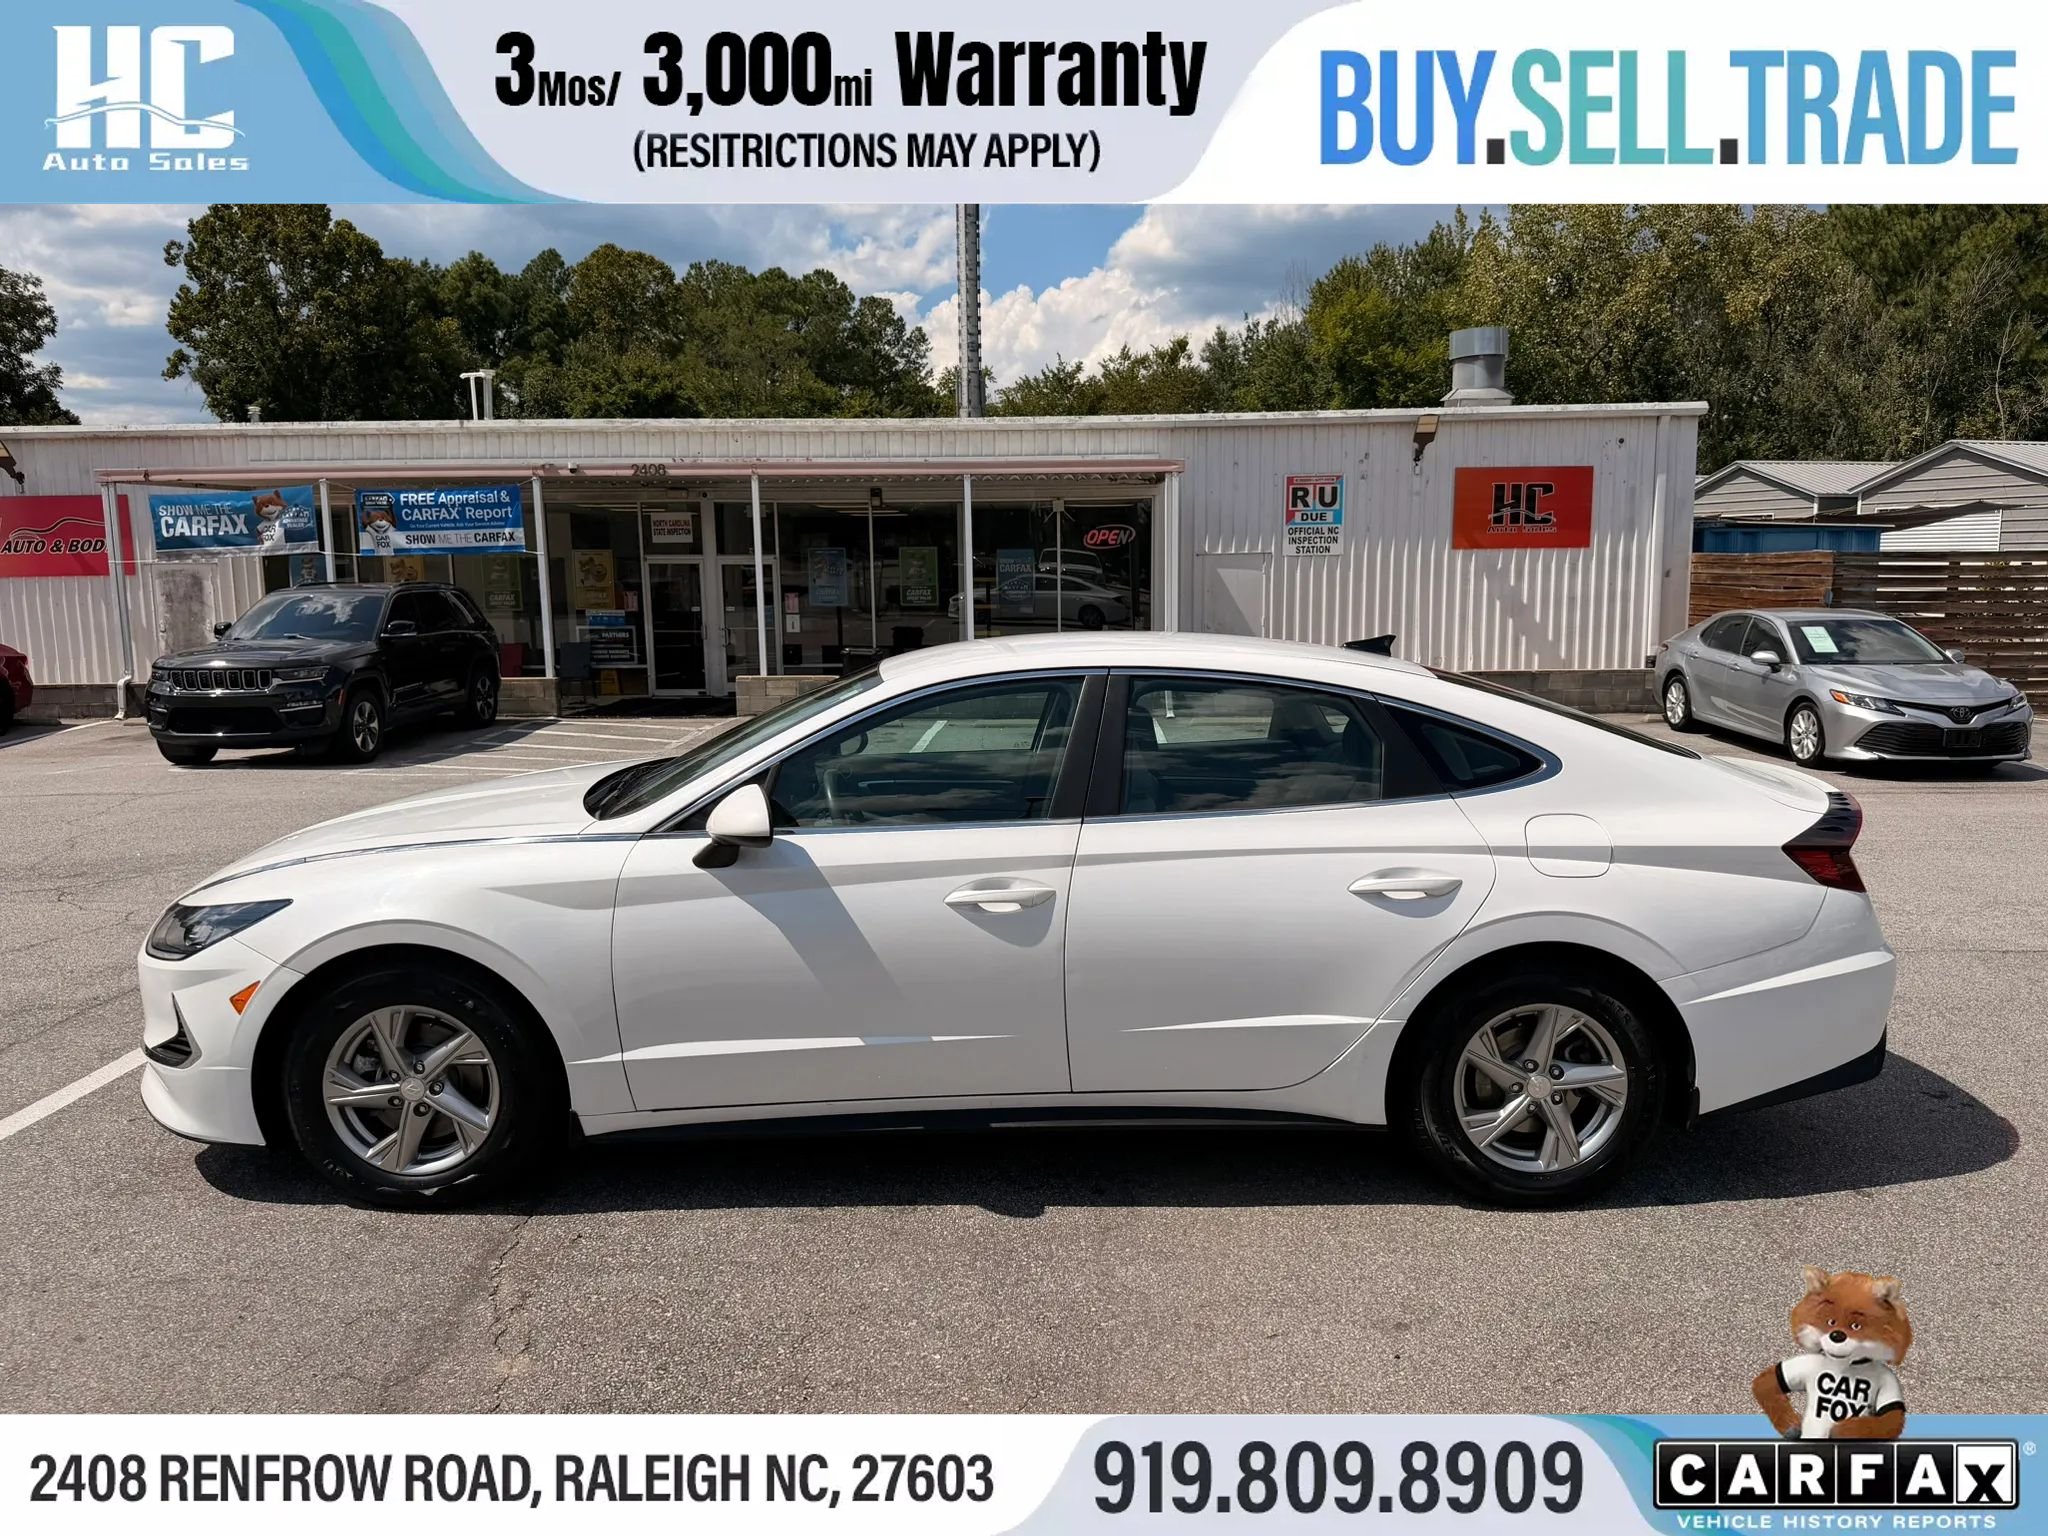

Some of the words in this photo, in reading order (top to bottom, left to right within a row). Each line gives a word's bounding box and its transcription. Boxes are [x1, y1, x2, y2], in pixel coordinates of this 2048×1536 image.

[631, 464, 666, 477] 2408
[400, 492, 436, 506] FREE
[438, 490, 498, 507] Appraisal
[500, 489, 511, 502] &
[1491, 482, 1554, 526] HC
[159, 504, 194, 516] SHOW
[195, 503, 213, 515] ME
[214, 502, 234, 514] THE
[402, 507, 460, 520] CARFAX
[465, 506, 513, 521] Report
[1301, 512, 1328, 521] DUE
[160, 514, 249, 538] CARFAX
[1288, 527, 1325, 535] OFFICIAL
[1327, 526, 1340, 535] NC
[405, 533, 436, 545] SHOW
[437, 534, 453, 545] ME
[455, 532, 473, 544] THE
[474, 531, 517, 543] CARFAX
[1087, 529, 1131, 545] OPEN
[1288, 536, 1339, 544] INSPECTION
[0, 538, 47, 554] AUTO
[49, 538, 65, 554] &
[67, 538, 108, 554] BOD
[1295, 545, 1331, 554] STATION
[1000, 563, 1032, 572] CARFAX
